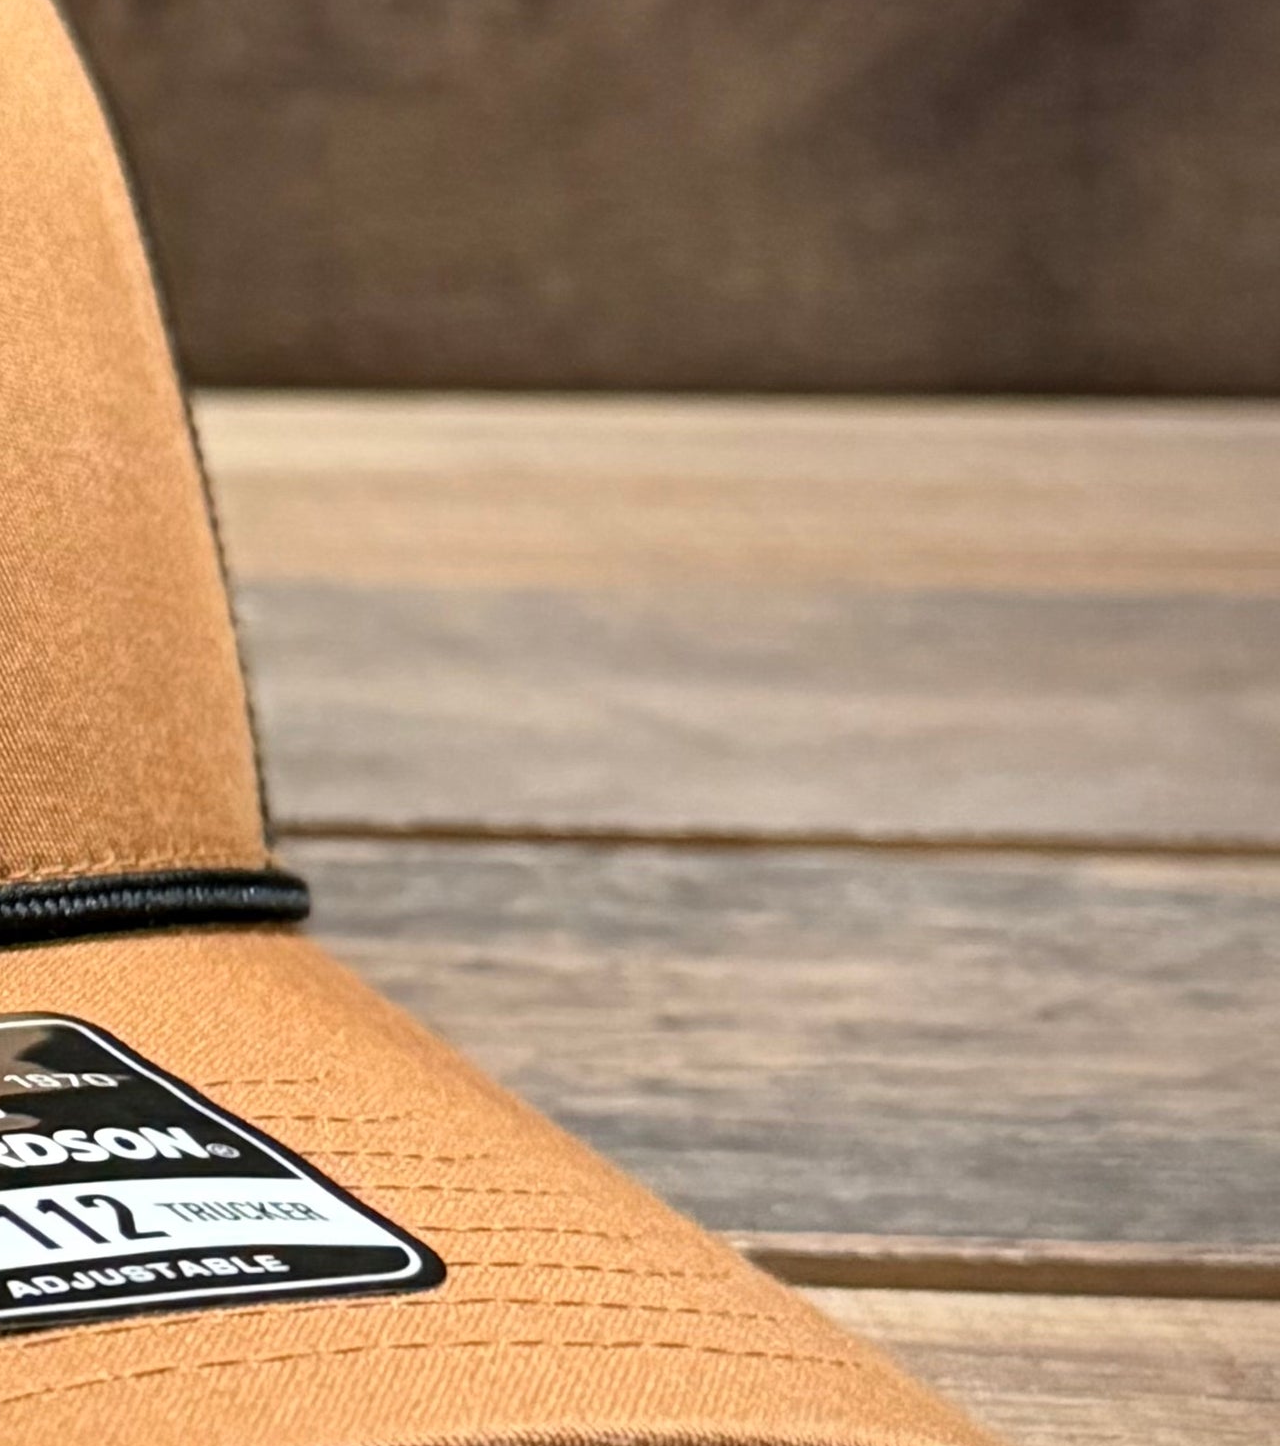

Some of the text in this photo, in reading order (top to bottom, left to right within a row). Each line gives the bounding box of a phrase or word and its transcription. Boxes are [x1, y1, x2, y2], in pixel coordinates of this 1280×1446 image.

[3, 1072, 121, 1089] 1970
[155, 1200, 329, 1223] TRUCKER
[6, 1254, 291, 1300] ADJUSTABLE
